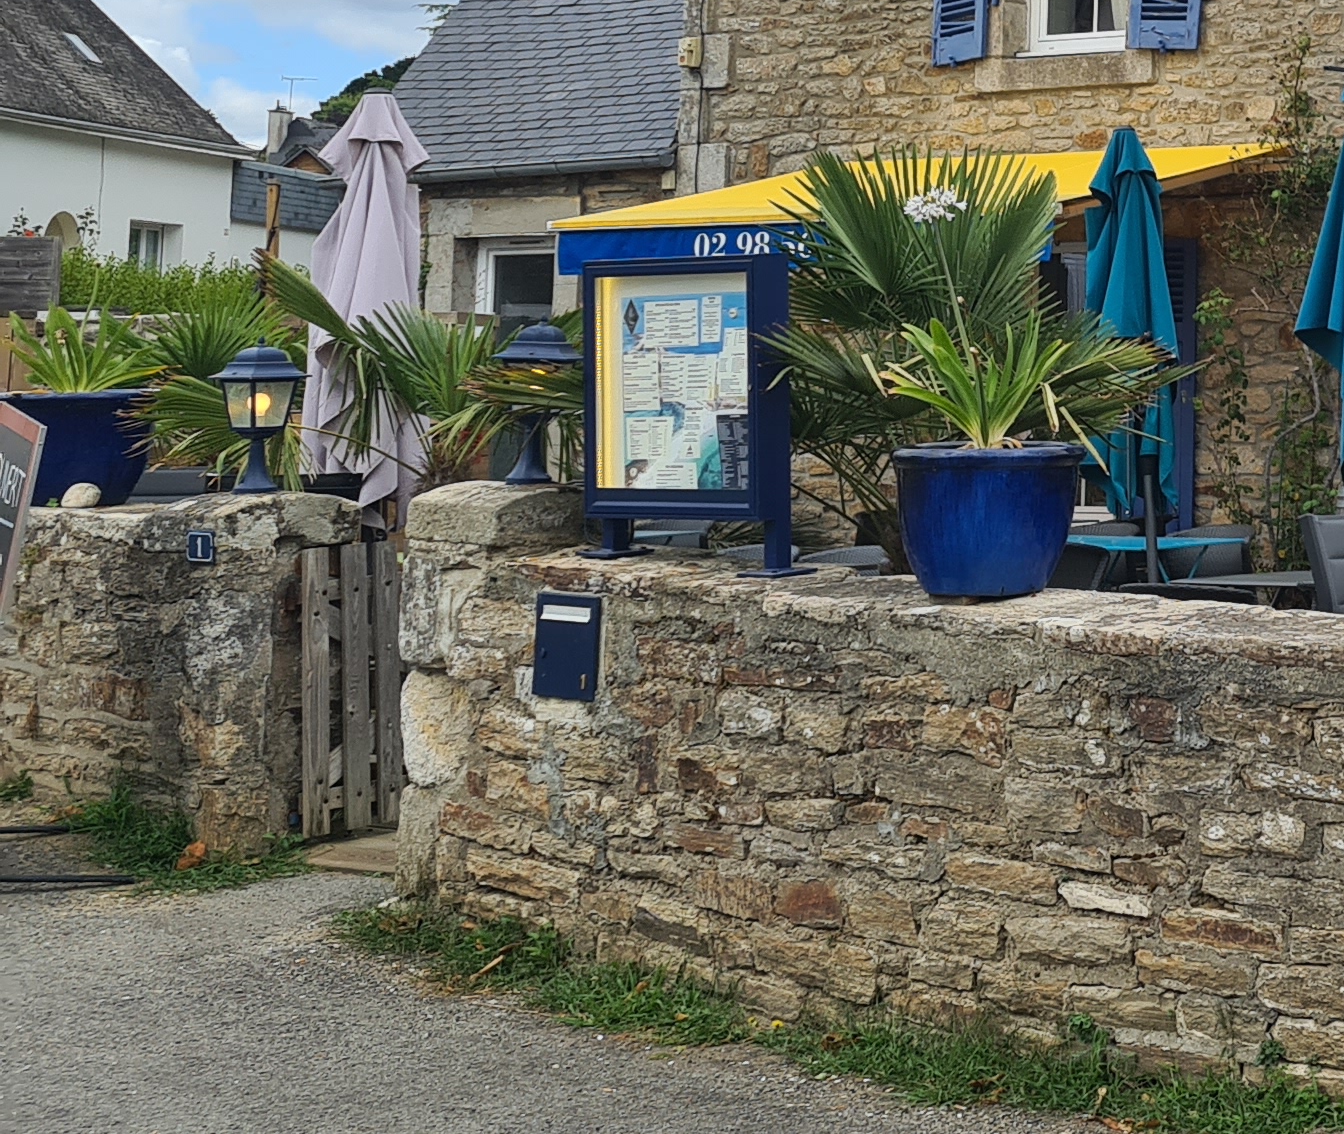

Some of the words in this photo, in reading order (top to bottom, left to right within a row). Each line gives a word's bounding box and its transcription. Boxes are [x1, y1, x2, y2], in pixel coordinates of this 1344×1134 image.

[694, 232, 727, 257] 02
[736, 231, 771, 255] 98
[195, 536, 203, 558] 1
